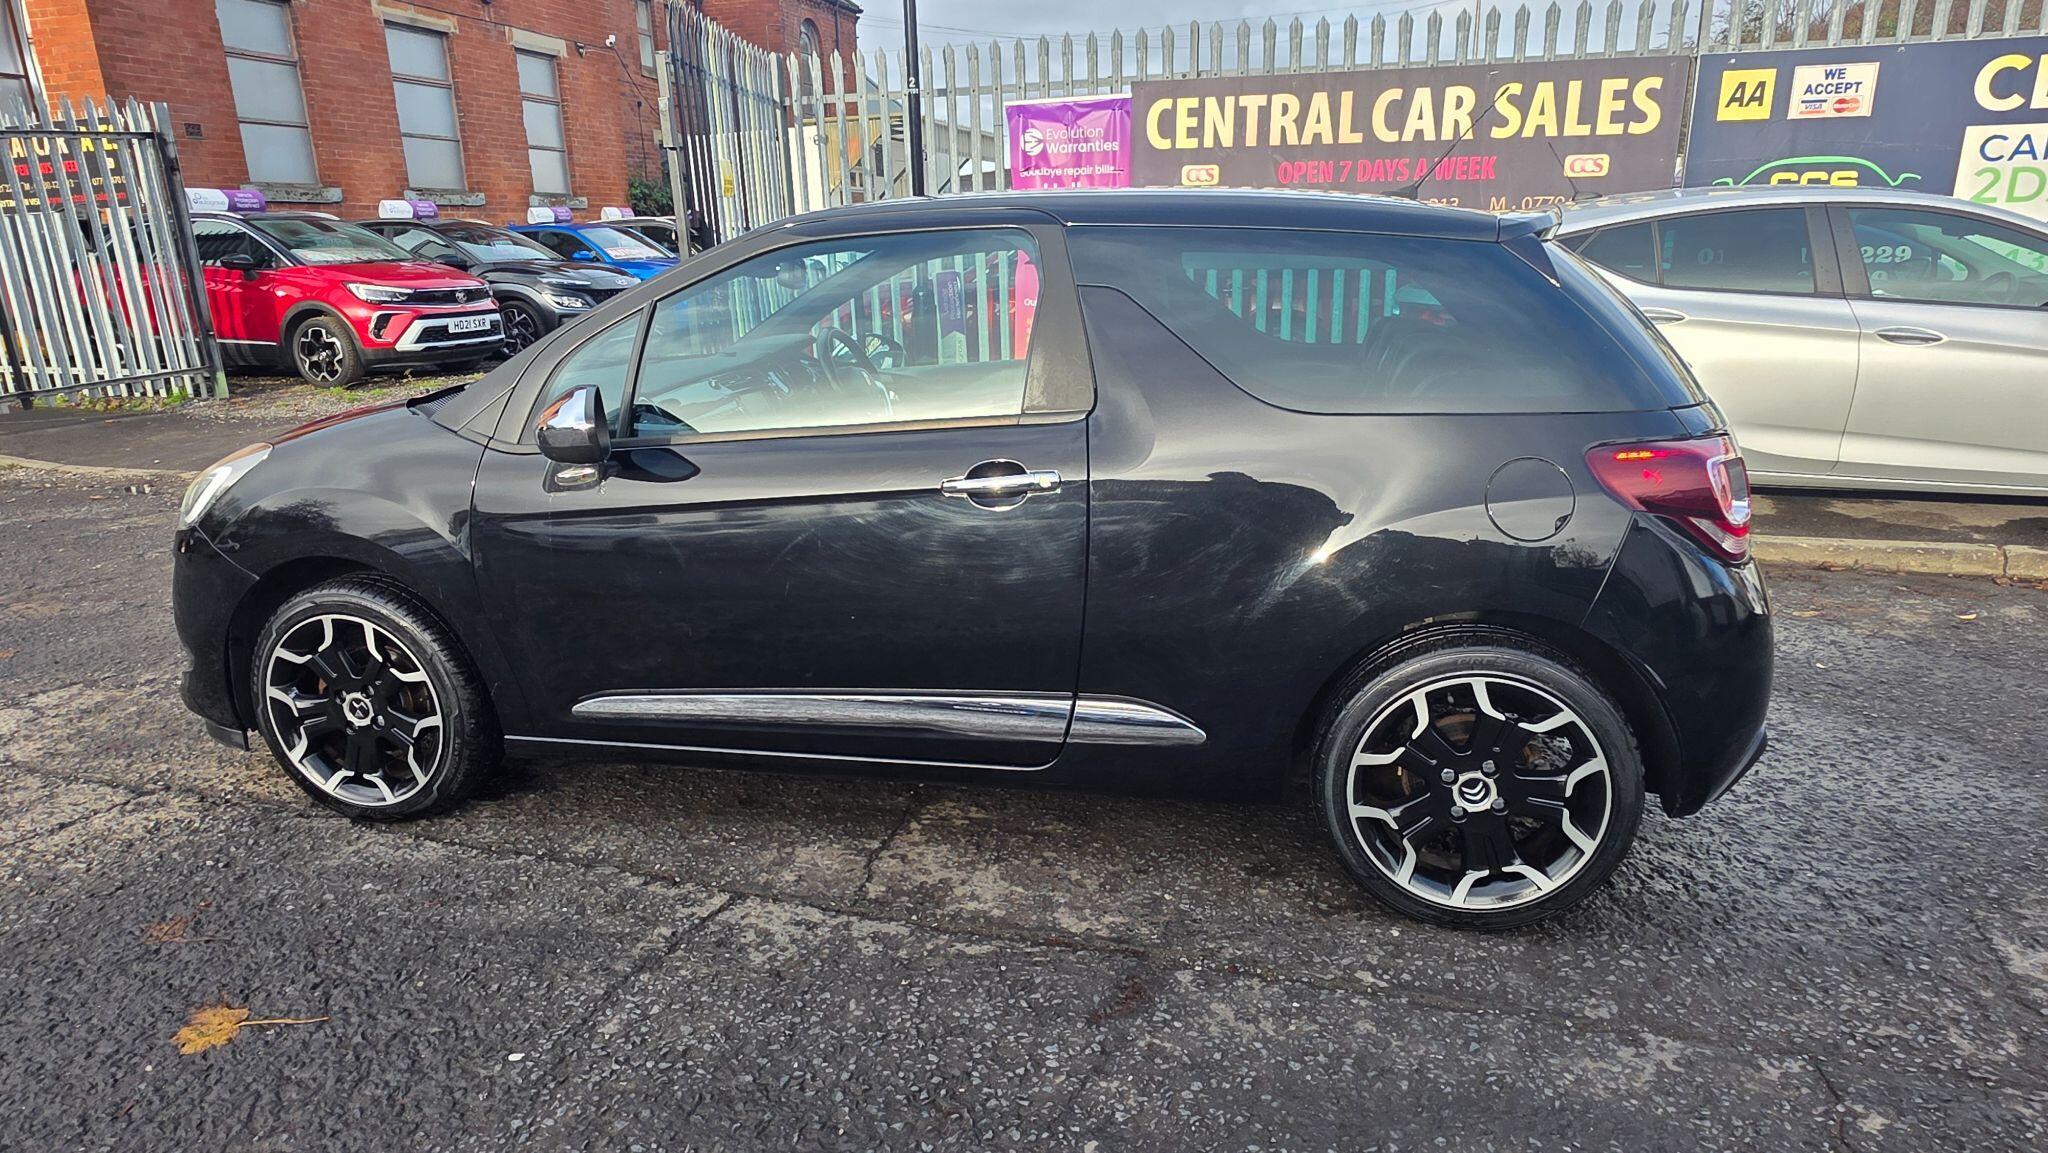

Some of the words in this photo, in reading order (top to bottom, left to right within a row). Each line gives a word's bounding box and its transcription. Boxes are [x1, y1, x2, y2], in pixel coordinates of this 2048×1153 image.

[1825, 68, 1847, 80] WE
[909, 77, 916, 88] 2
[1803, 82, 1863, 95] ACCEPT
[1724, 81, 1767, 108] AA
[1146, 91, 1363, 149] CENTRAL
[1371, 85, 1474, 143] CAR
[1490, 77, 1663, 139] SALES
[1046, 126, 1104, 140] Evolution
[1046, 140, 1119, 154] Warranties
[1980, 134, 2048, 162] CA
[1064, 165, 1093, 178] repair
[1278, 161, 1334, 184] OPEN
[1340, 161, 1353, 182] 7
[1357, 159, 1410, 182] DAYS
[1413, 158, 1430, 180] A
[1434, 156, 1496, 180] WEEK
[1569, 157, 1604, 173] CCS
[1186, 168, 1215, 182] CCS
[1970, 166, 2048, 204] 2D
[454, 320, 472, 330] HD21
[473, 318, 487, 328] SXR
